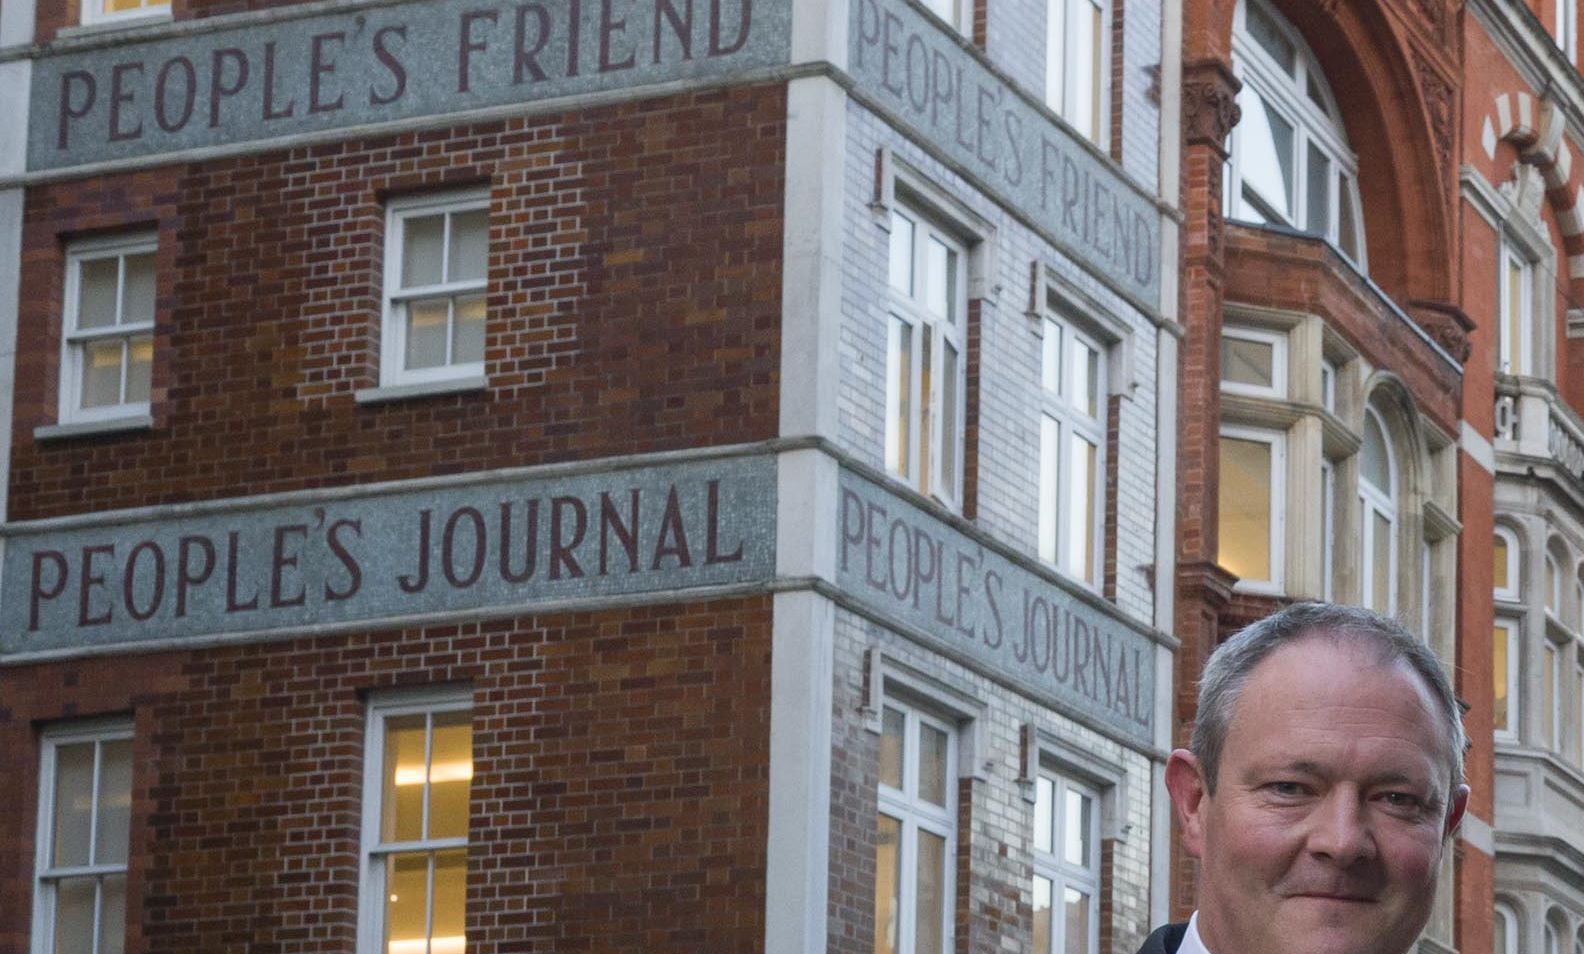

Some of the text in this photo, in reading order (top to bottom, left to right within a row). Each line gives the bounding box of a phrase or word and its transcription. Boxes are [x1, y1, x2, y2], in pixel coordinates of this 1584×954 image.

[57, 0, 753, 150] PEOPLE'S FRIEND
[856, 0, 1152, 288] PEOPLE'S FRIEND
[28, 479, 744, 632] PEOPLE'S JOURNAL
[840, 487, 1150, 727] PEOPLE'S JOURNAL
